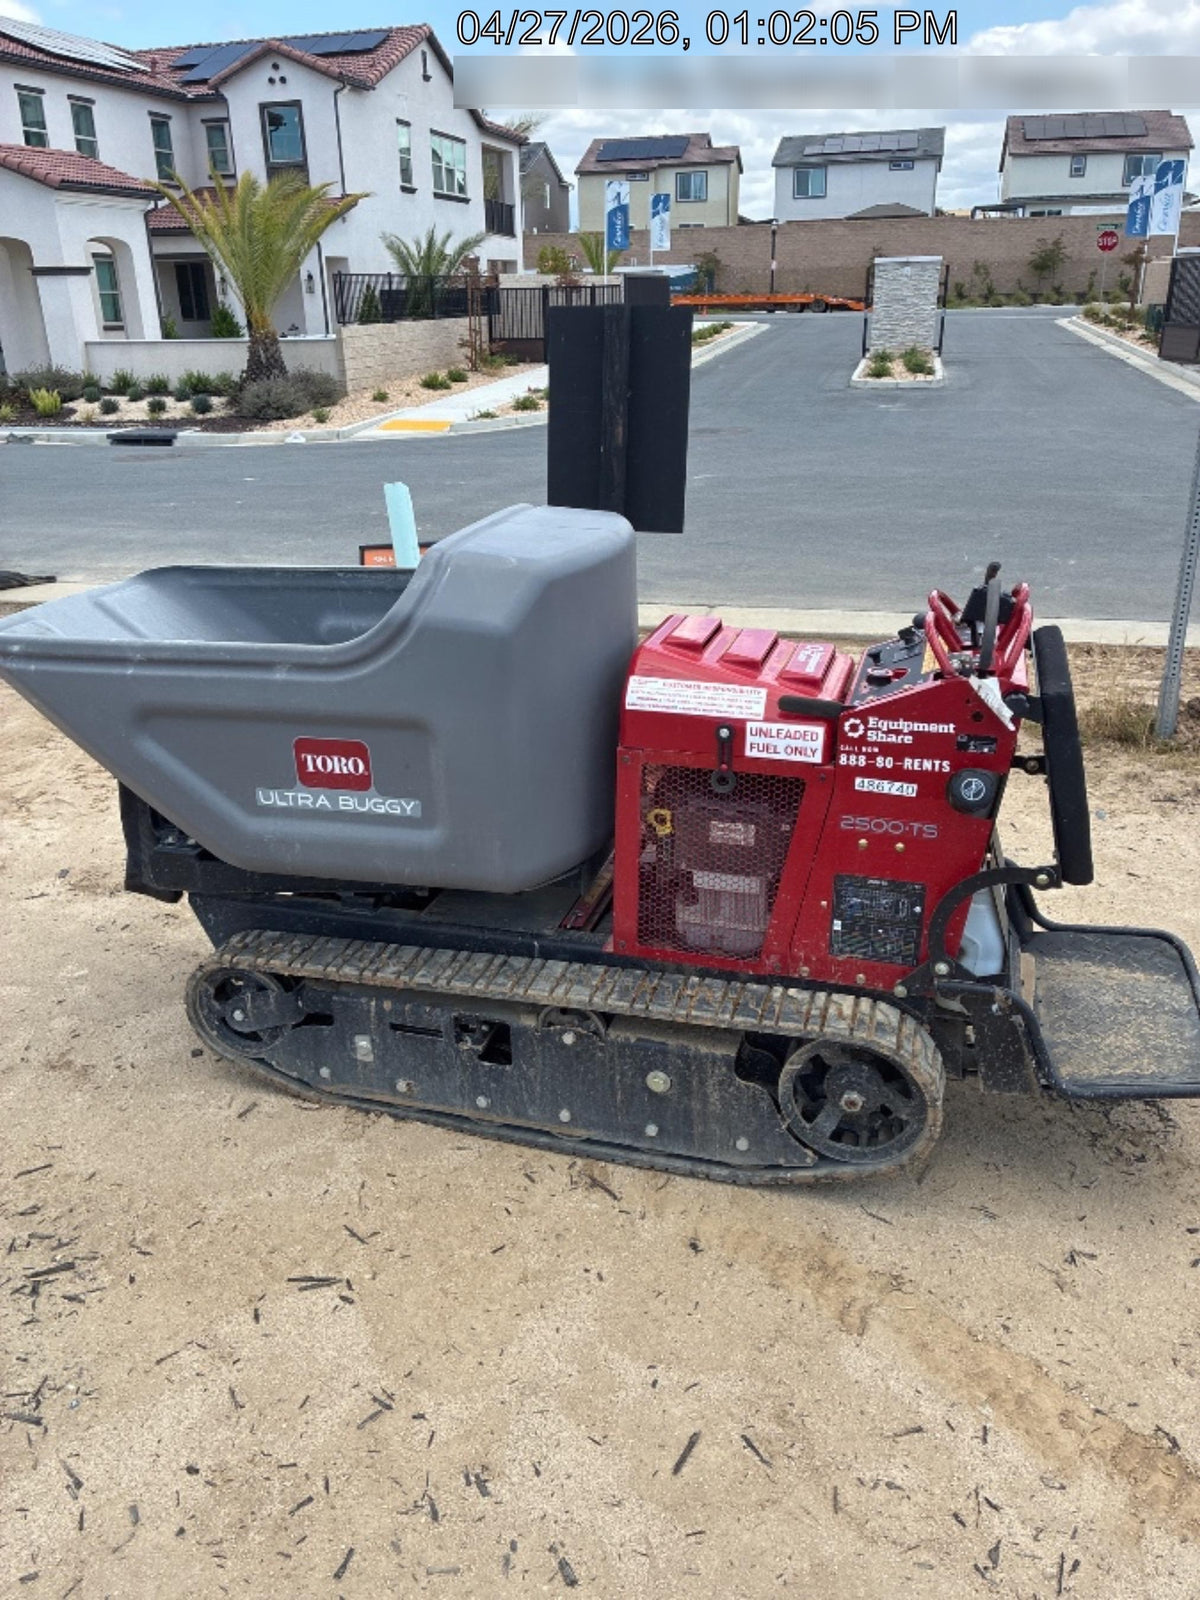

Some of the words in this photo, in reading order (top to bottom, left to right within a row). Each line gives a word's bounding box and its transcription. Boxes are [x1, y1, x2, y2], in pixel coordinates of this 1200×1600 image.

[1098, 236, 1118, 247] STOP
[749, 726, 819, 742] UNLEADED
[867, 716, 956, 734] Equipment
[867, 730, 913, 744] Share
[749, 742, 781, 755] FUEL
[783, 744, 818, 758] ONLY
[301, 753, 366, 776] TORO
[839, 753, 951, 773] 888-80-RENTS
[857, 778, 916, 796] 486740
[258, 790, 332, 809] ULTRA
[338, 796, 416, 815] BUGGY
